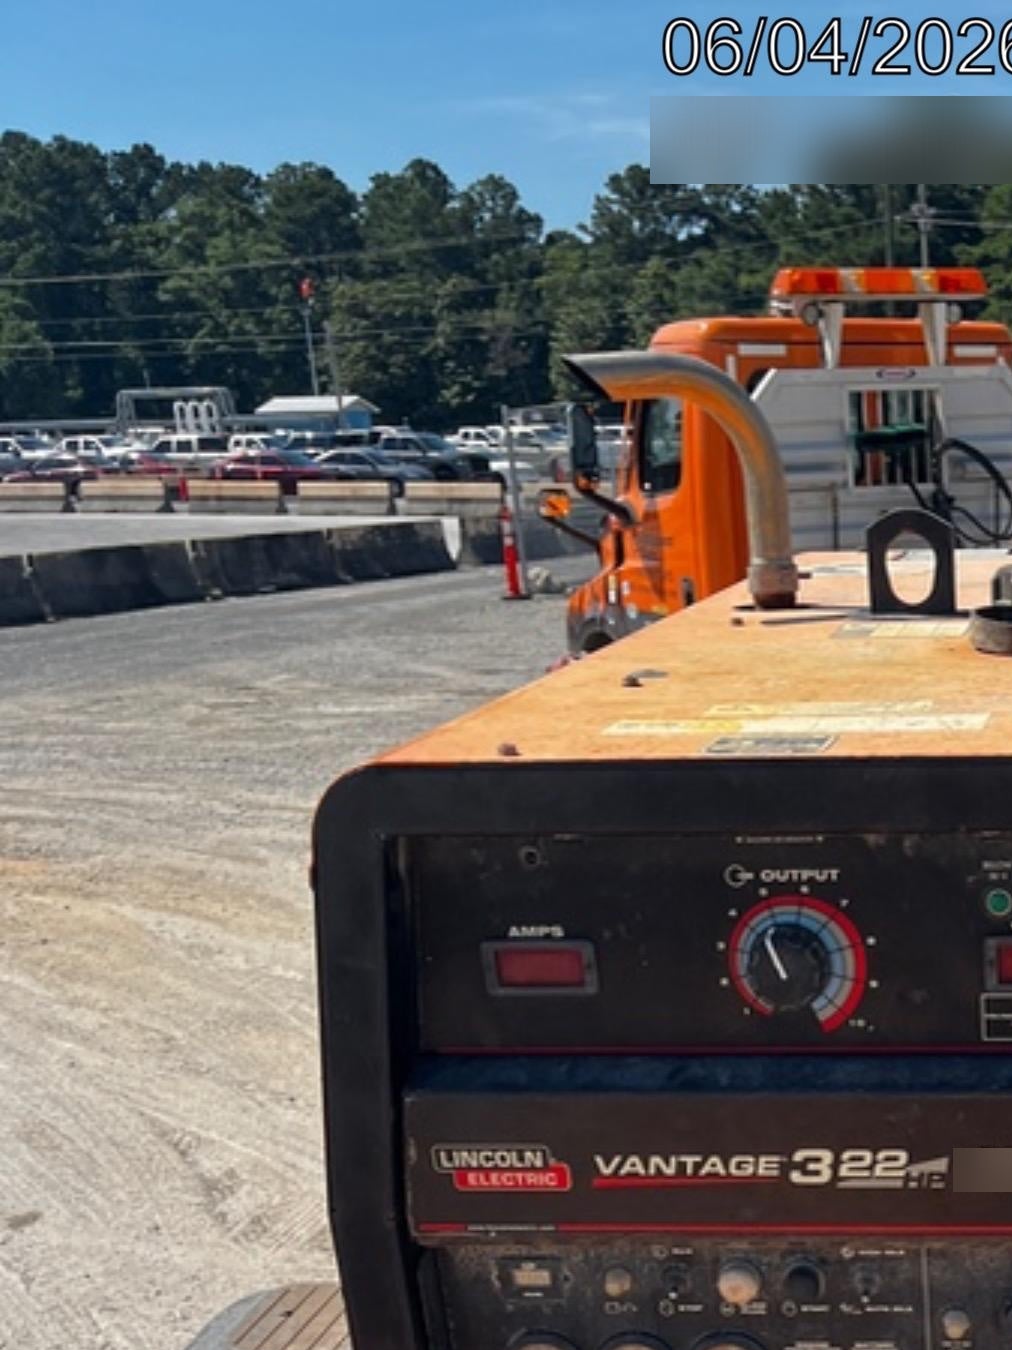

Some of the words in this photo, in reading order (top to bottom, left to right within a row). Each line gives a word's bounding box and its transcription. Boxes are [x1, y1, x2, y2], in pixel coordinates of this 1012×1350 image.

[760, 869, 840, 883] OUTPUT
[508, 926, 565, 938] AMPS
[439, 1151, 544, 1168] LINCOLN
[593, 1154, 781, 1177] VANTAGE
[789, 1148, 909, 1186] 322
[466, 1172, 557, 1187] ELECTRIC
